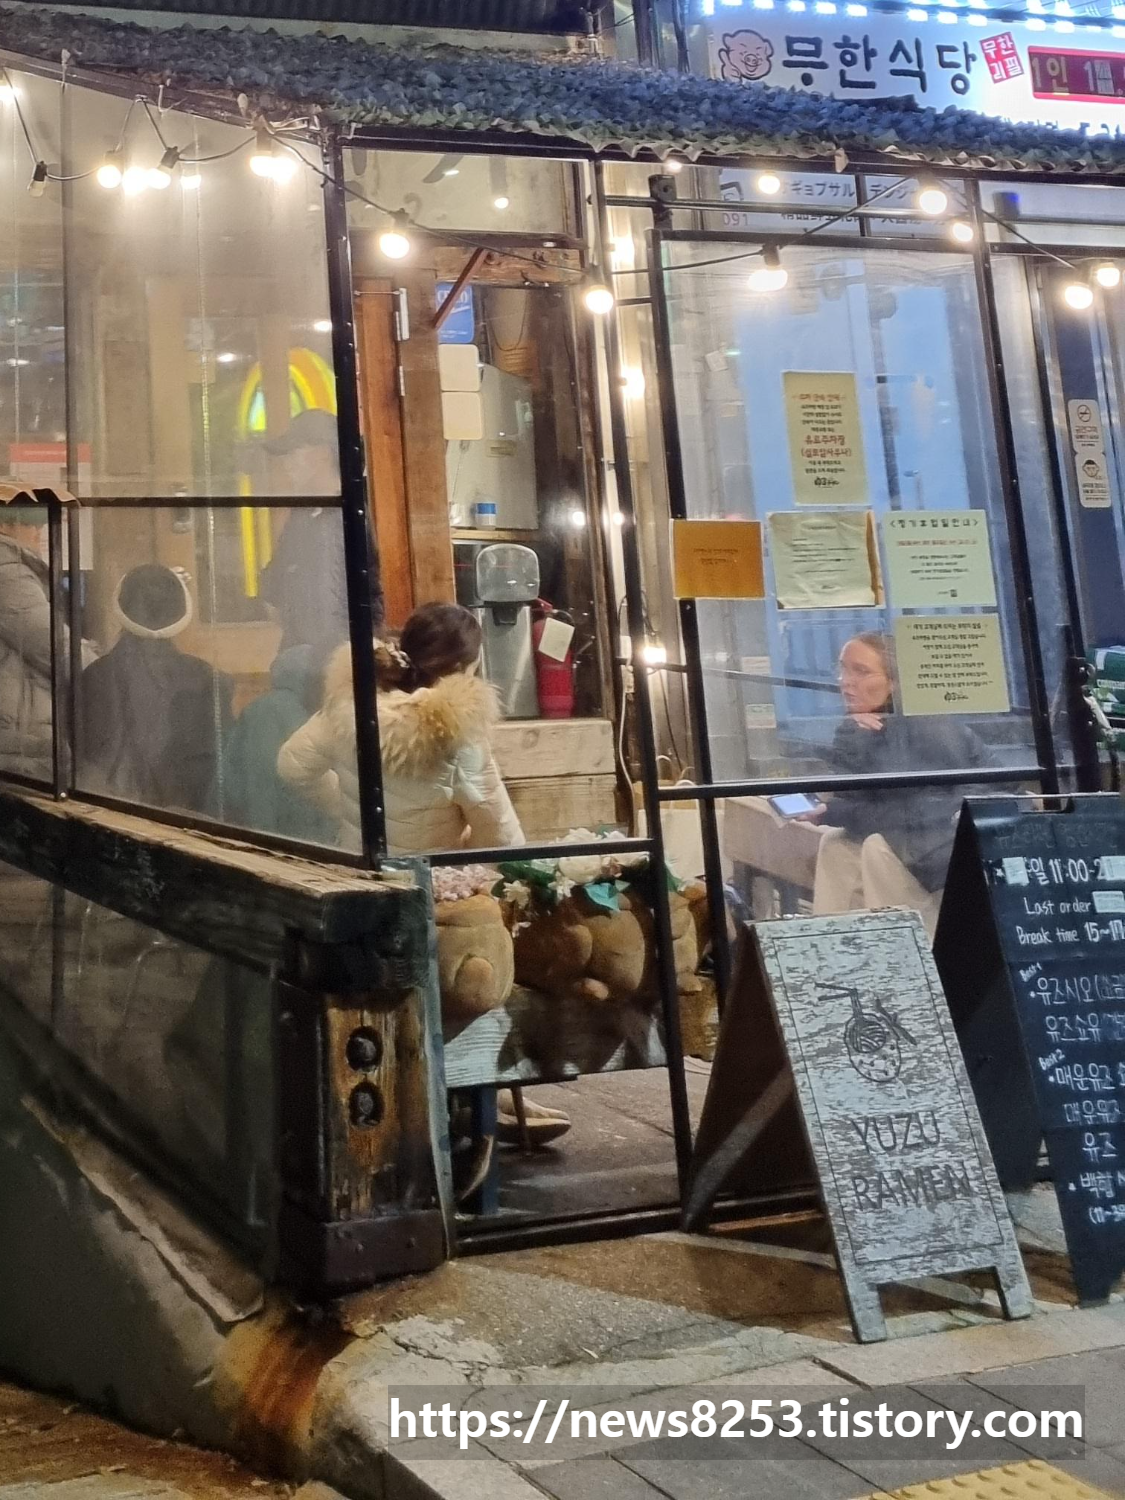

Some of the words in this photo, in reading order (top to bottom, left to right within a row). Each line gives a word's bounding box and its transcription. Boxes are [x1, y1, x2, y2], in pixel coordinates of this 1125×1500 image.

[1023, 896, 1056, 916] Last
[1059, 897, 1092, 914] order
[1015, 925, 1053, 946] Break
[850, 1110, 941, 1156] YUZU
[851, 1160, 973, 1213] RAMEN
